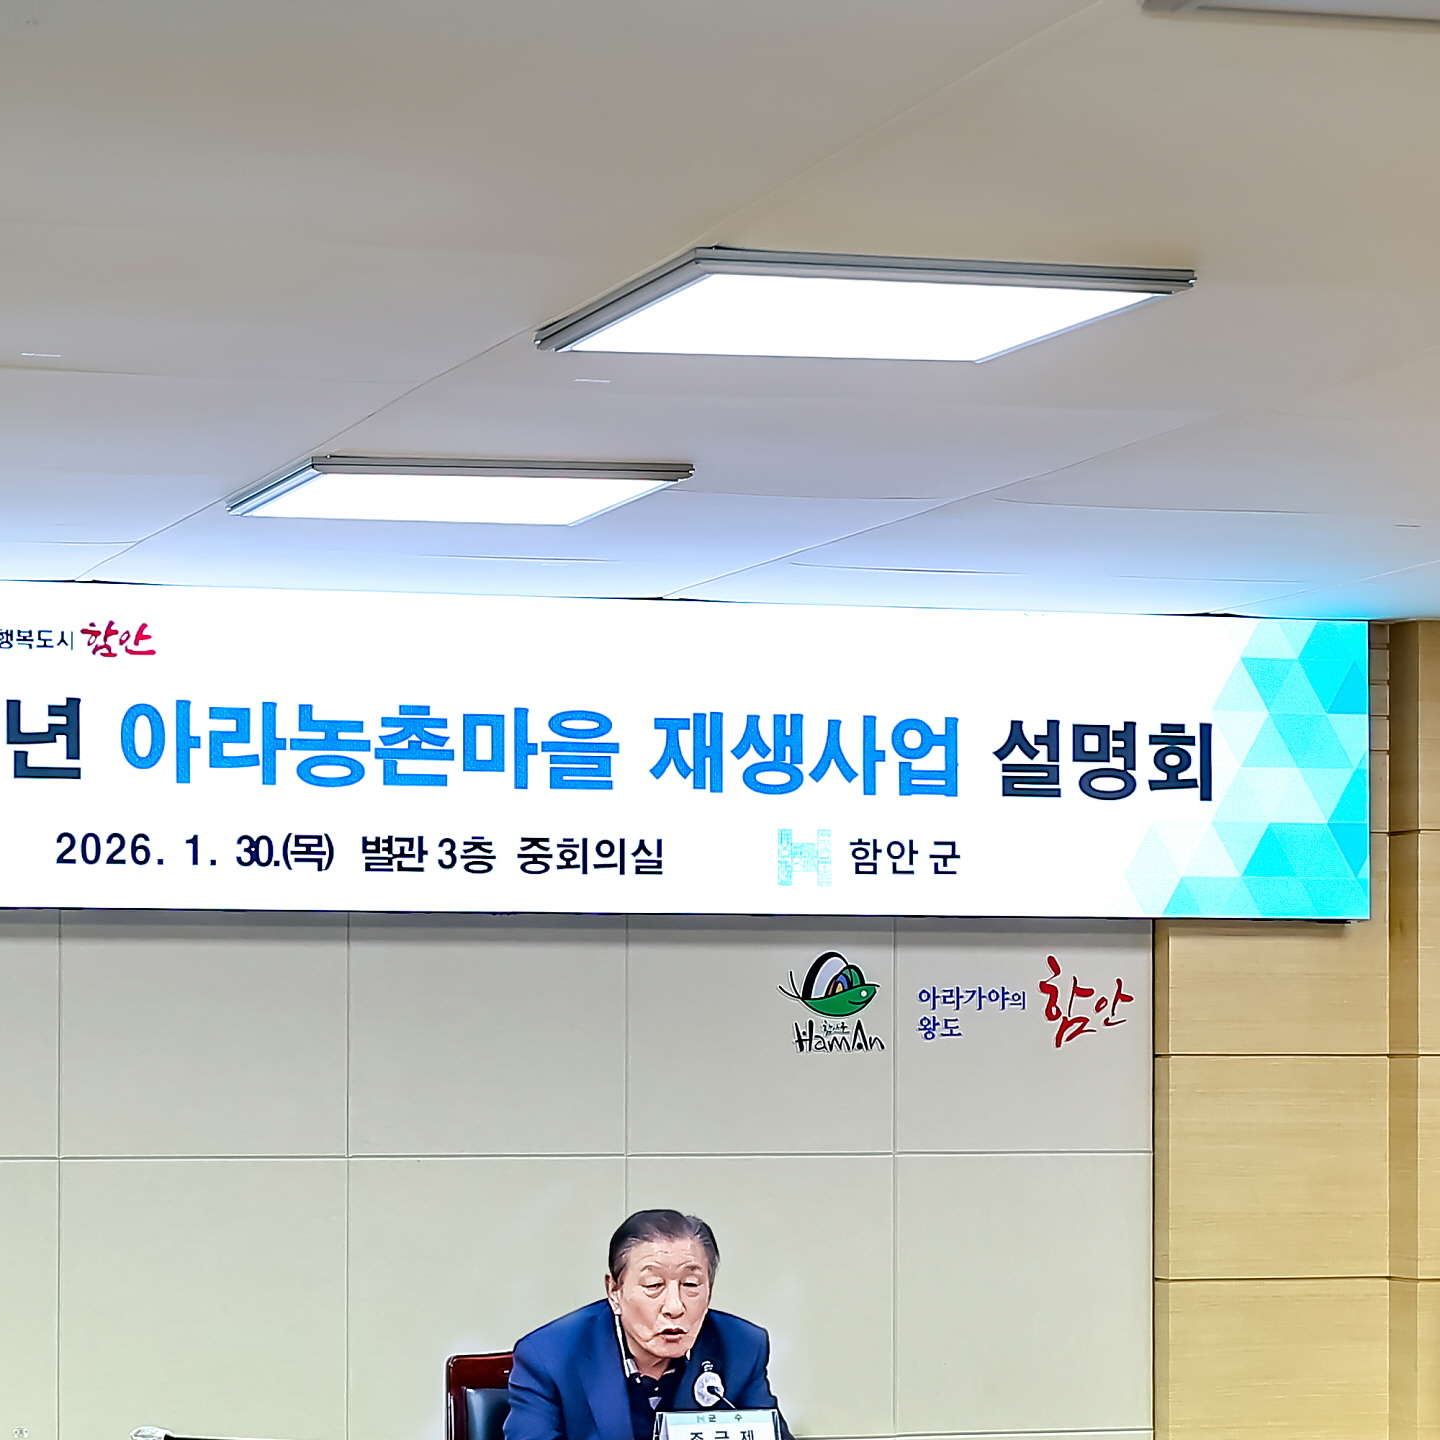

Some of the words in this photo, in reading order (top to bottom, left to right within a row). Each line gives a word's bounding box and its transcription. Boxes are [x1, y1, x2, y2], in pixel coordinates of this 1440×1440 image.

[79, 620, 157, 658] 함안
[120, 699, 620, 791] 아라농촌마을
[648, 711, 960, 798] 재생사업
[991, 719, 1213, 802] 설명회
[55, 831, 164, 866] 2026.
[185, 834, 217, 866] 1.
[361, 834, 429, 873] 별관
[437, 835, 497, 875] 3층
[516, 836, 664, 876] 중회의실
[918, 985, 1026, 1011] 아라가야의
[1038, 955, 1134, 1049] 함안
[793, 1019, 885, 1052] HamAn
[917, 1016, 963, 1040] 왕도
